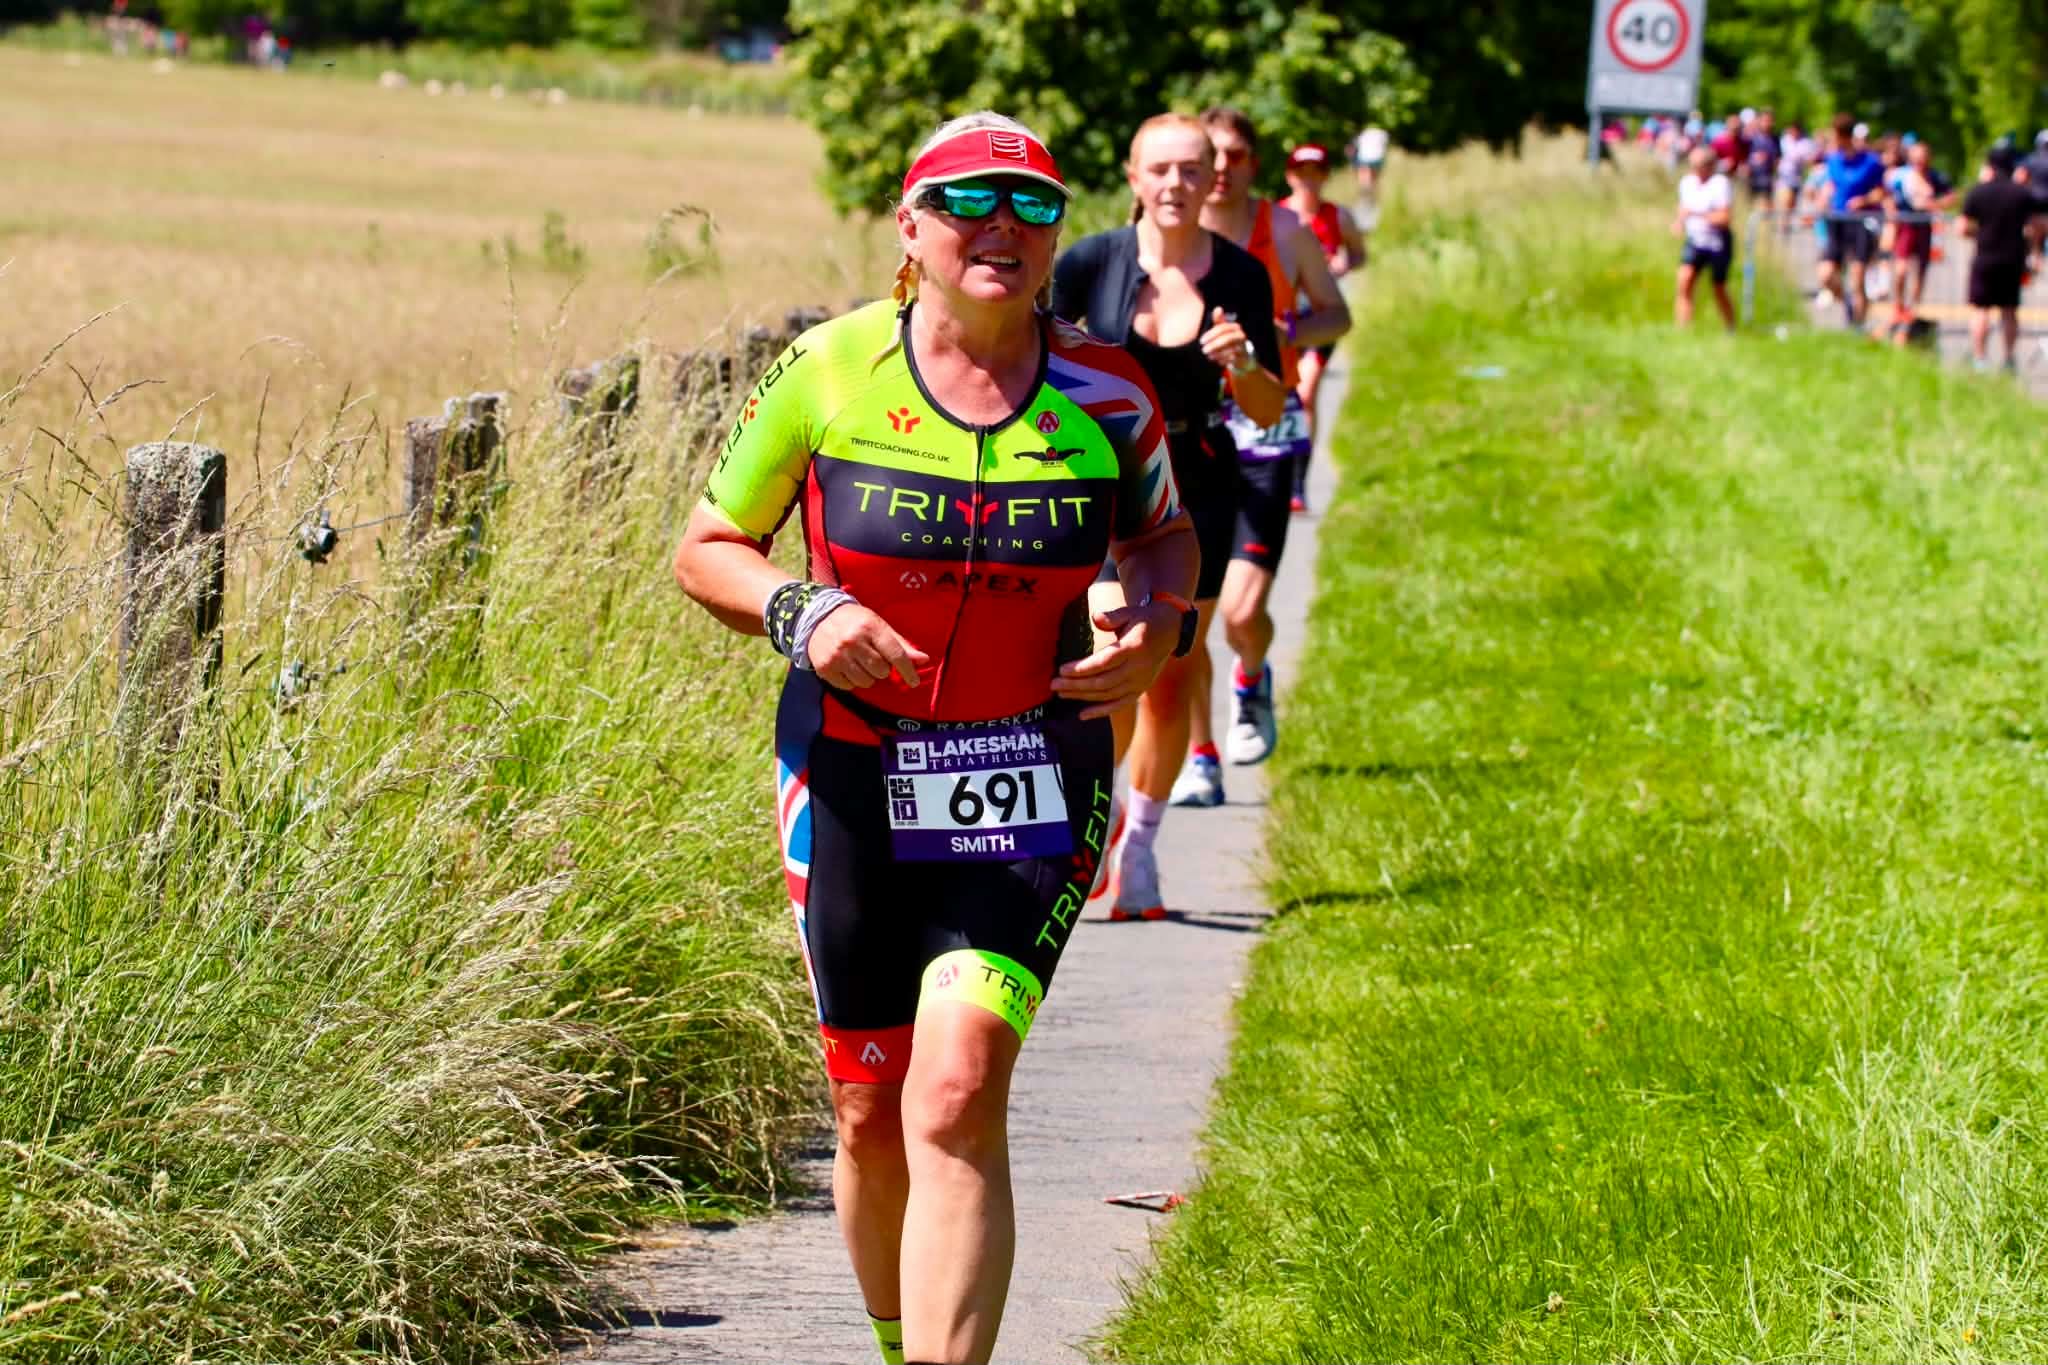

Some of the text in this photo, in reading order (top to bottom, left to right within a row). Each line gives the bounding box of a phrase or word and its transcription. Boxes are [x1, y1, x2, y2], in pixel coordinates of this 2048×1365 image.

[1621, 15, 1677, 47] 40
[850, 437, 951, 463] TRIFITCOACHING.CO.UK
[901, 532, 1044, 550] COACHING
[934, 571, 1040, 594] APEX
[928, 732, 1046, 758] LAKESMAN
[929, 750, 1048, 770] TRIATHLONS
[949, 771, 1037, 826] 691
[951, 832, 1016, 853] SMITH
